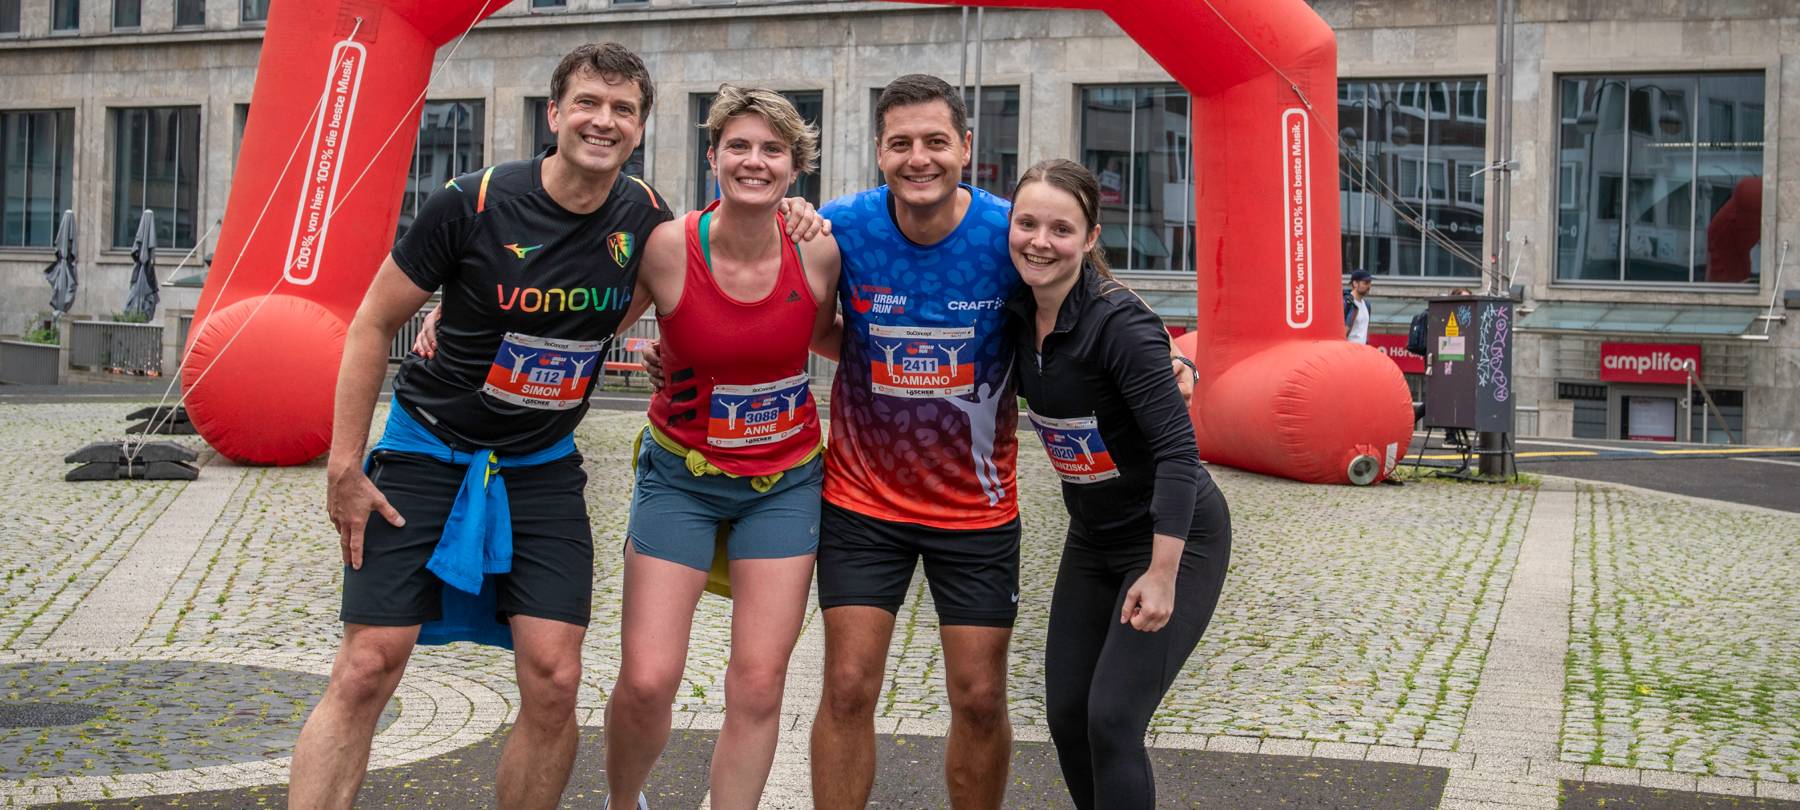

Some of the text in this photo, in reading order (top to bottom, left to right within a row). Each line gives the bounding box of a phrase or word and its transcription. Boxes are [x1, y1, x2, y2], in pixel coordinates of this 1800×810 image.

[297, 56, 355, 270] 100% von hier. 100% die beste Musik.
[1292, 121, 1305, 316] 100% von hier. 100% die beste Musik.
[873, 293, 907, 305] URBAN
[947, 300, 995, 311] CRAFT
[872, 303, 891, 314] RUN
[903, 359, 936, 372] 2411
[1603, 351, 1697, 375] amplifon
[535, 370, 560, 383] 112
[892, 374, 950, 386] DAMIANO
[521, 384, 561, 397] SIMON
[745, 409, 779, 424] 3088
[744, 423, 777, 436] ANNE
